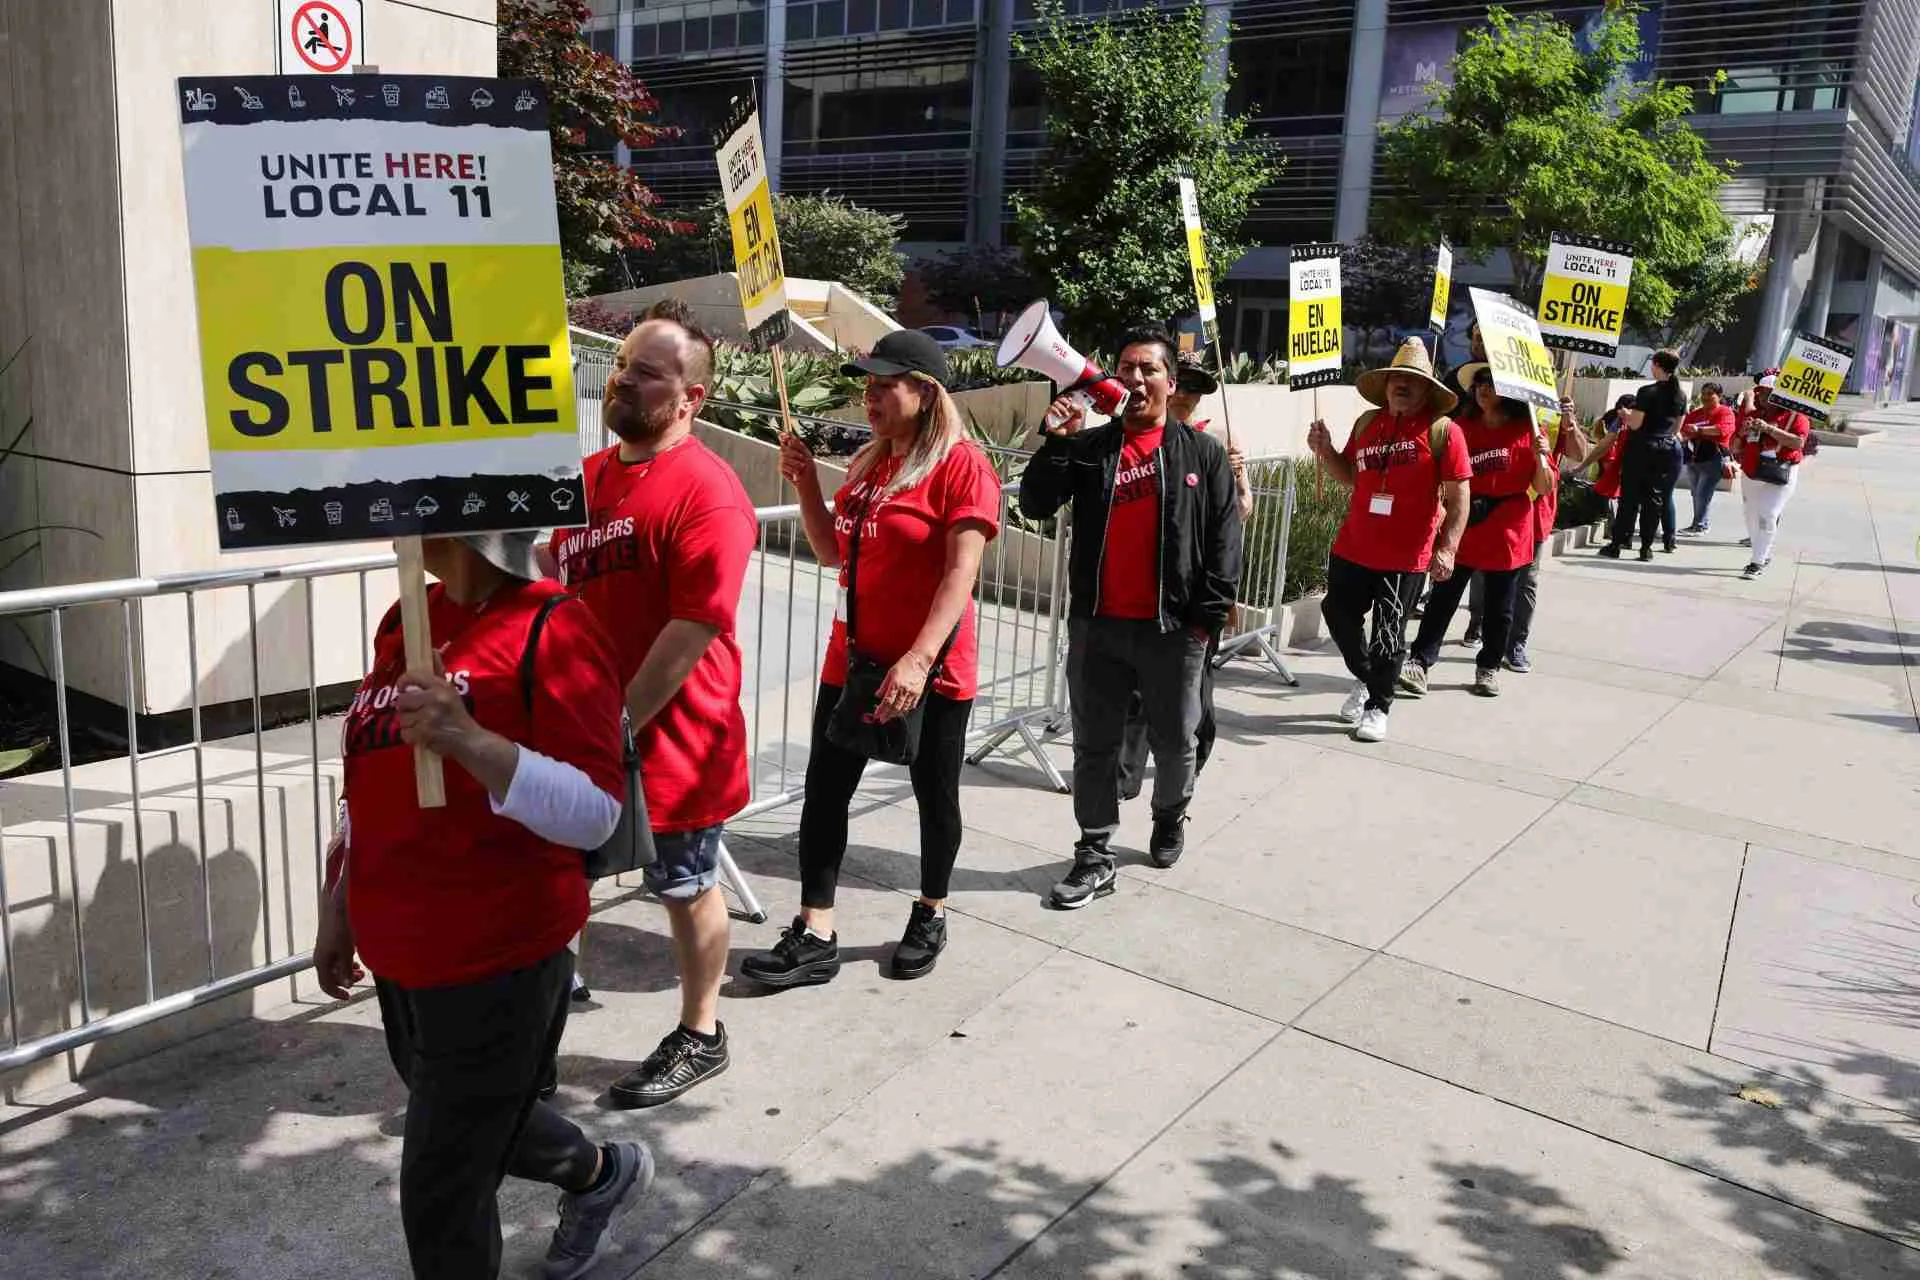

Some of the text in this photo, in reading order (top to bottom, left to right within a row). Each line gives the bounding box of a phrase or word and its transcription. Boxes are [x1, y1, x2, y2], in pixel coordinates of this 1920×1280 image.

[261, 153, 486, 181] UNITE HERE!
[731, 151, 759, 193] LOCAL 11
[263, 183, 492, 218] LOCAL 11
[743, 201, 762, 251] EN
[1564, 262, 1616, 278] LOCAL 11
[1566, 253, 1592, 264] UNITE
[1300, 279, 1332, 291] LOCAL 11
[1571, 282, 1602, 307] ON
[324, 261, 454, 345] ON
[1308, 303, 1324, 328] EN
[1544, 299, 1619, 331] STRIKE
[1292, 328, 1340, 358] HUELGA
[1507, 336, 1531, 361] ON
[1492, 350, 1553, 387] STRIKE
[1802, 367, 1825, 385] ON
[227, 344, 559, 438] STRIKE
[1780, 374, 1834, 405] STRIKE
